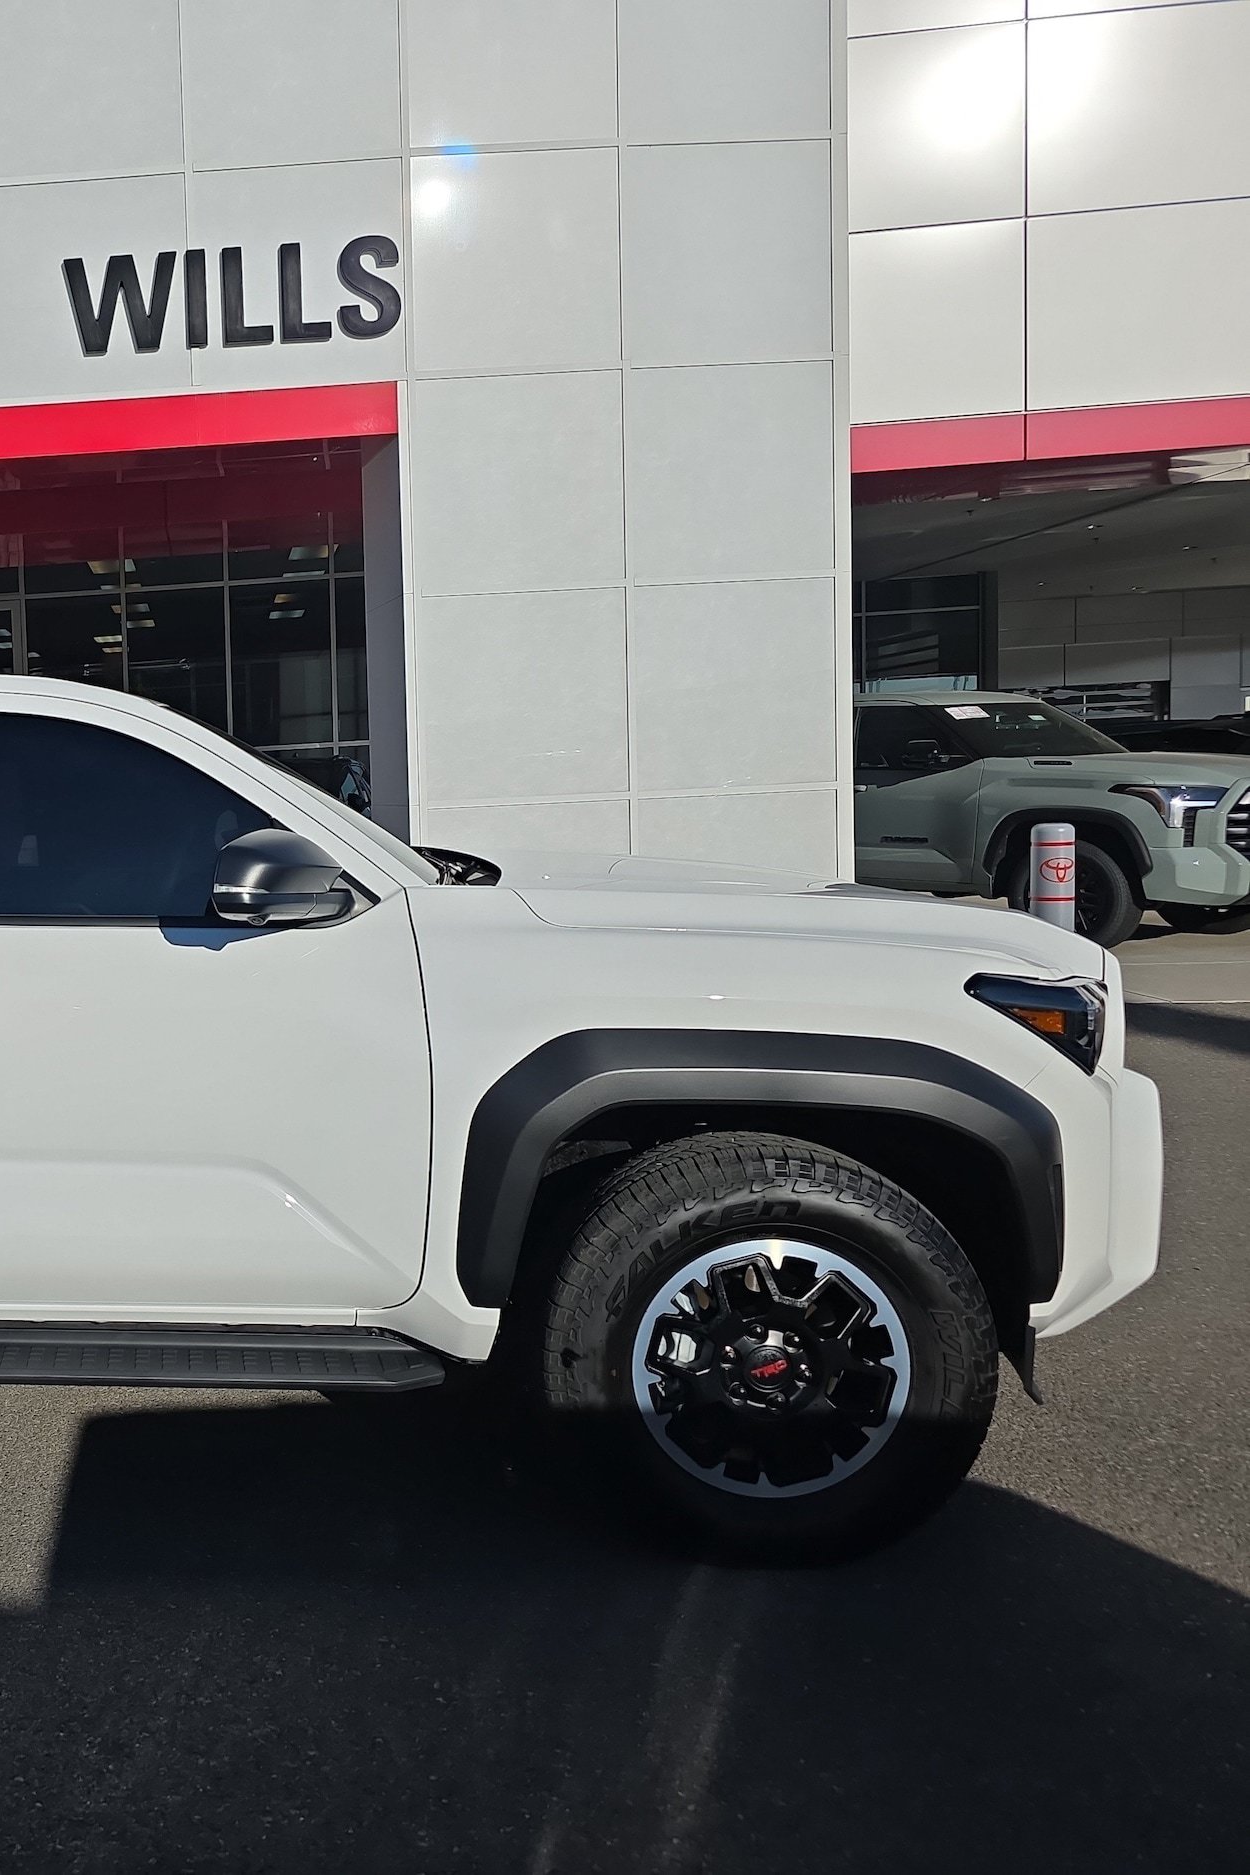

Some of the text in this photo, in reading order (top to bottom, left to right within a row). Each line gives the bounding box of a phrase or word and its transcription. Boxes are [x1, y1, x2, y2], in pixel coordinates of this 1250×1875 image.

[61, 235, 402, 357] WILLS
[606, 1199, 801, 1322] FALKEN
[750, 1359, 788, 1378] TRD
